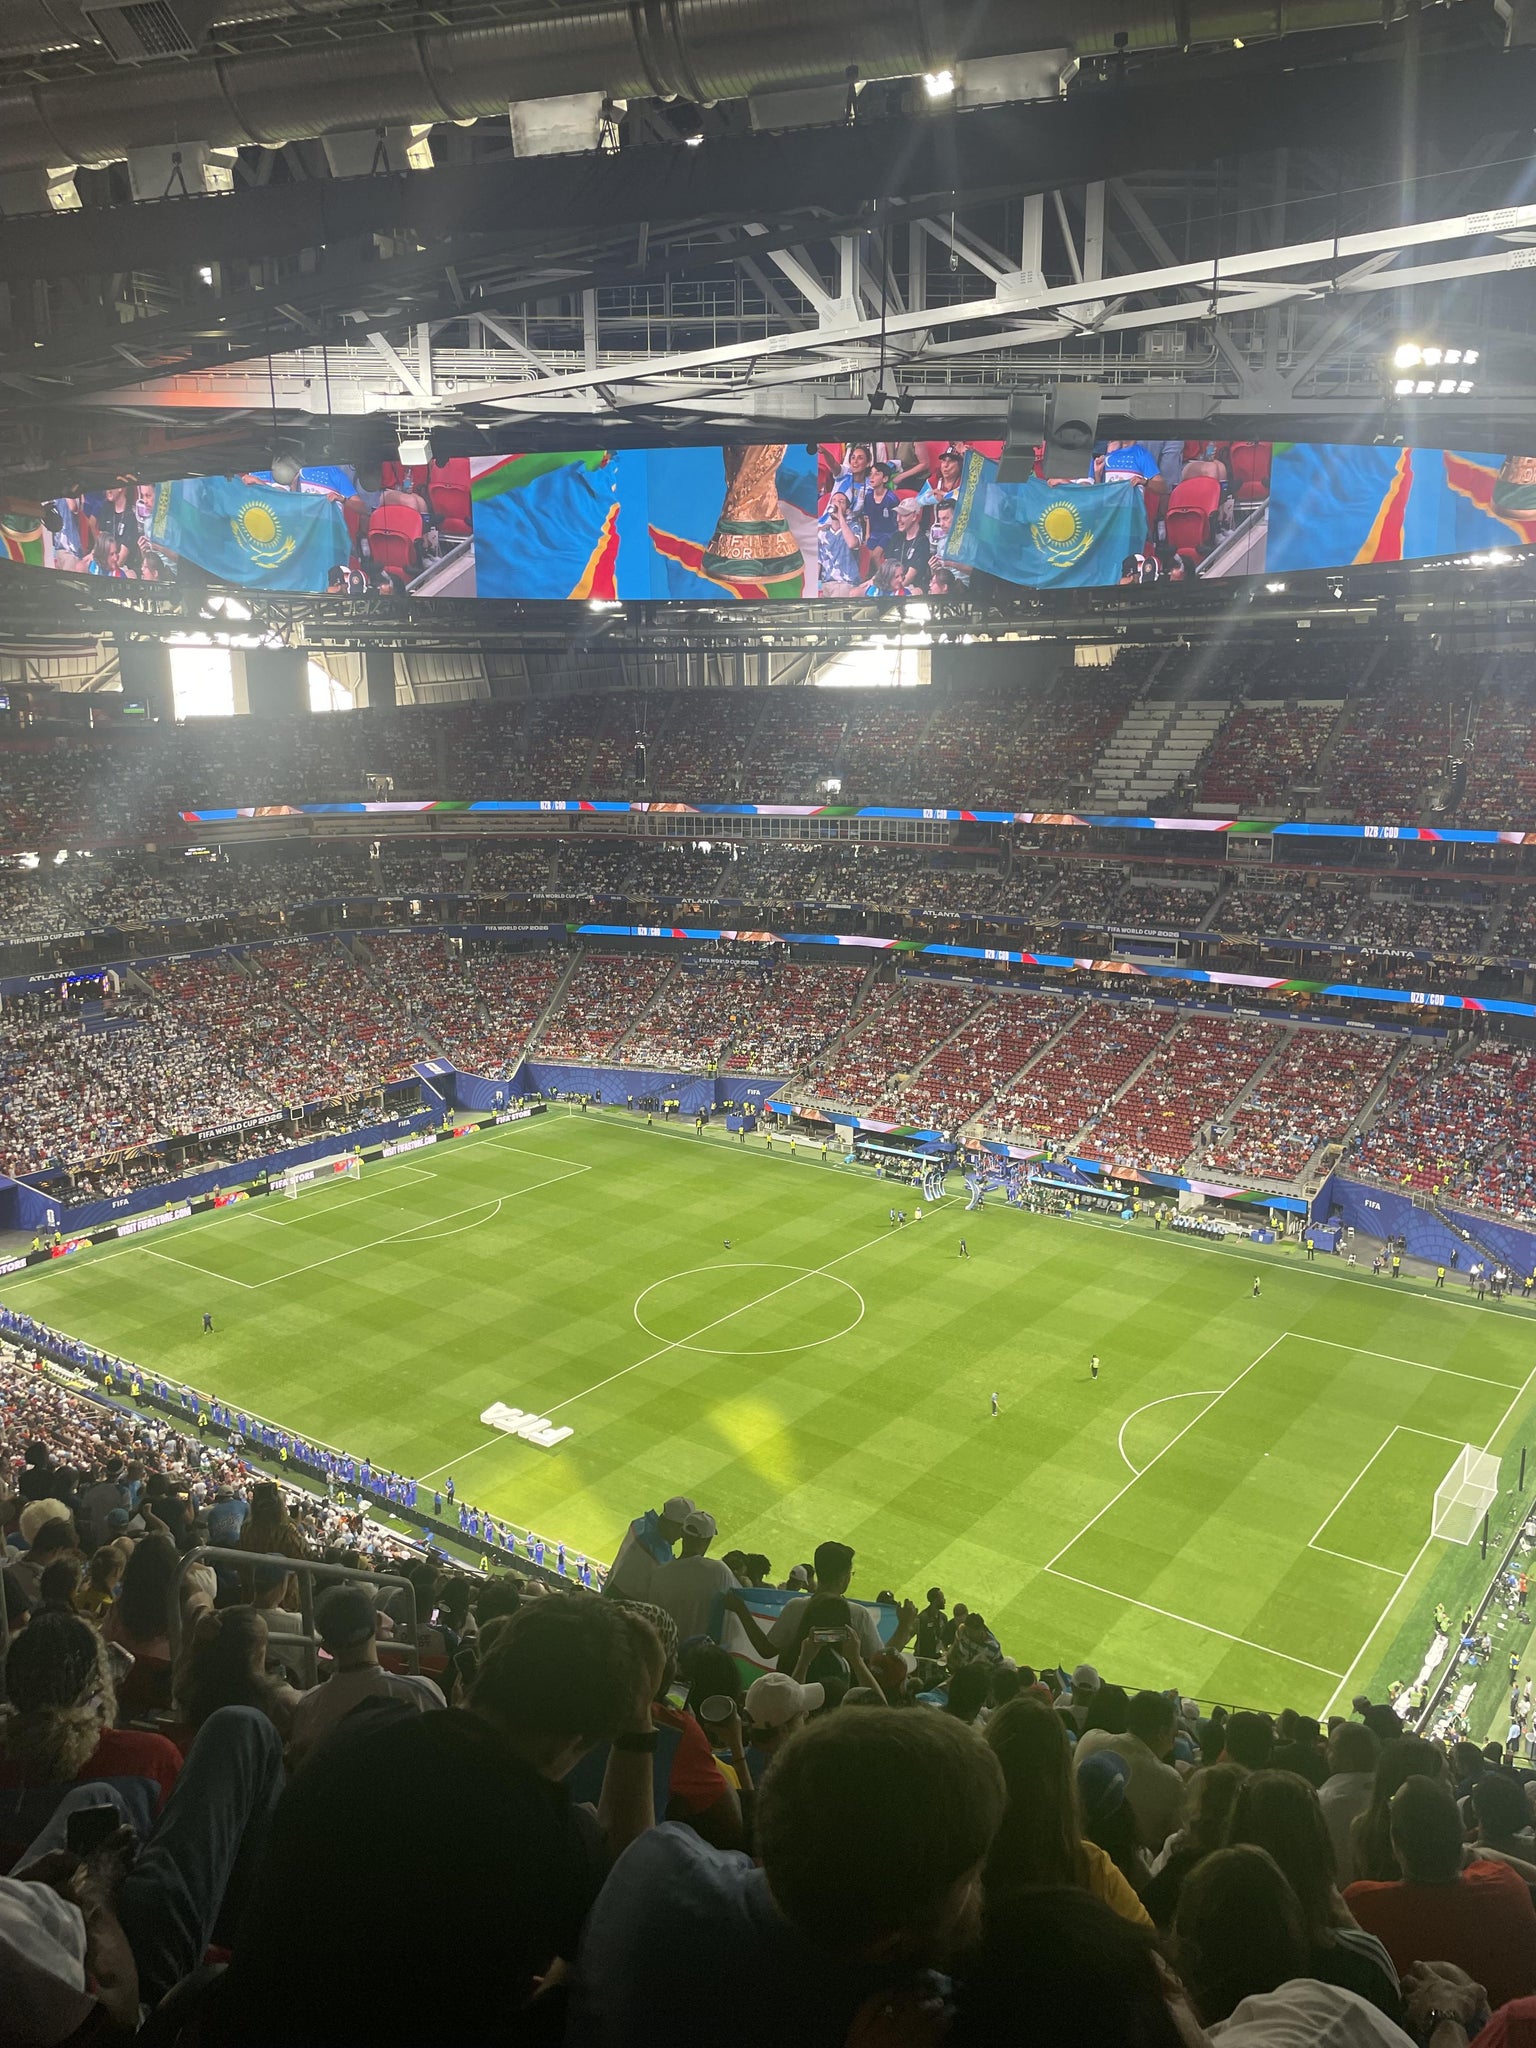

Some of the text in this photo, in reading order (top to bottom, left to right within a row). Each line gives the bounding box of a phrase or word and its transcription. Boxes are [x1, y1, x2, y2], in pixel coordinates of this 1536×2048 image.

[731, 533, 787, 547] FIFA
[185, 912, 226, 923] ATLANTA
[922, 909, 961, 919] ATLANTA
[1120, 927, 1144, 935] WORLD
[10, 938, 25, 946] FIFA
[25, 935, 49, 943] WORLD
[272, 936, 309, 947] ATLANTA
[1360, 947, 1415, 958] ATLANTA
[28, 970, 76, 983] ATLANTA
[747, 1088, 761, 1096] FIFA
[198, 1112, 283, 1140] FIFA WORLD CUP 2026
[398, 1119, 411, 1128] FIFA
[270, 1170, 315, 1191] FIFA STORE
[112, 1198, 130, 1209] FIFA
[1364, 1199, 1381, 1211] FIFA
[117, 1205, 192, 1237] VISIT FIFASTORE.COM
